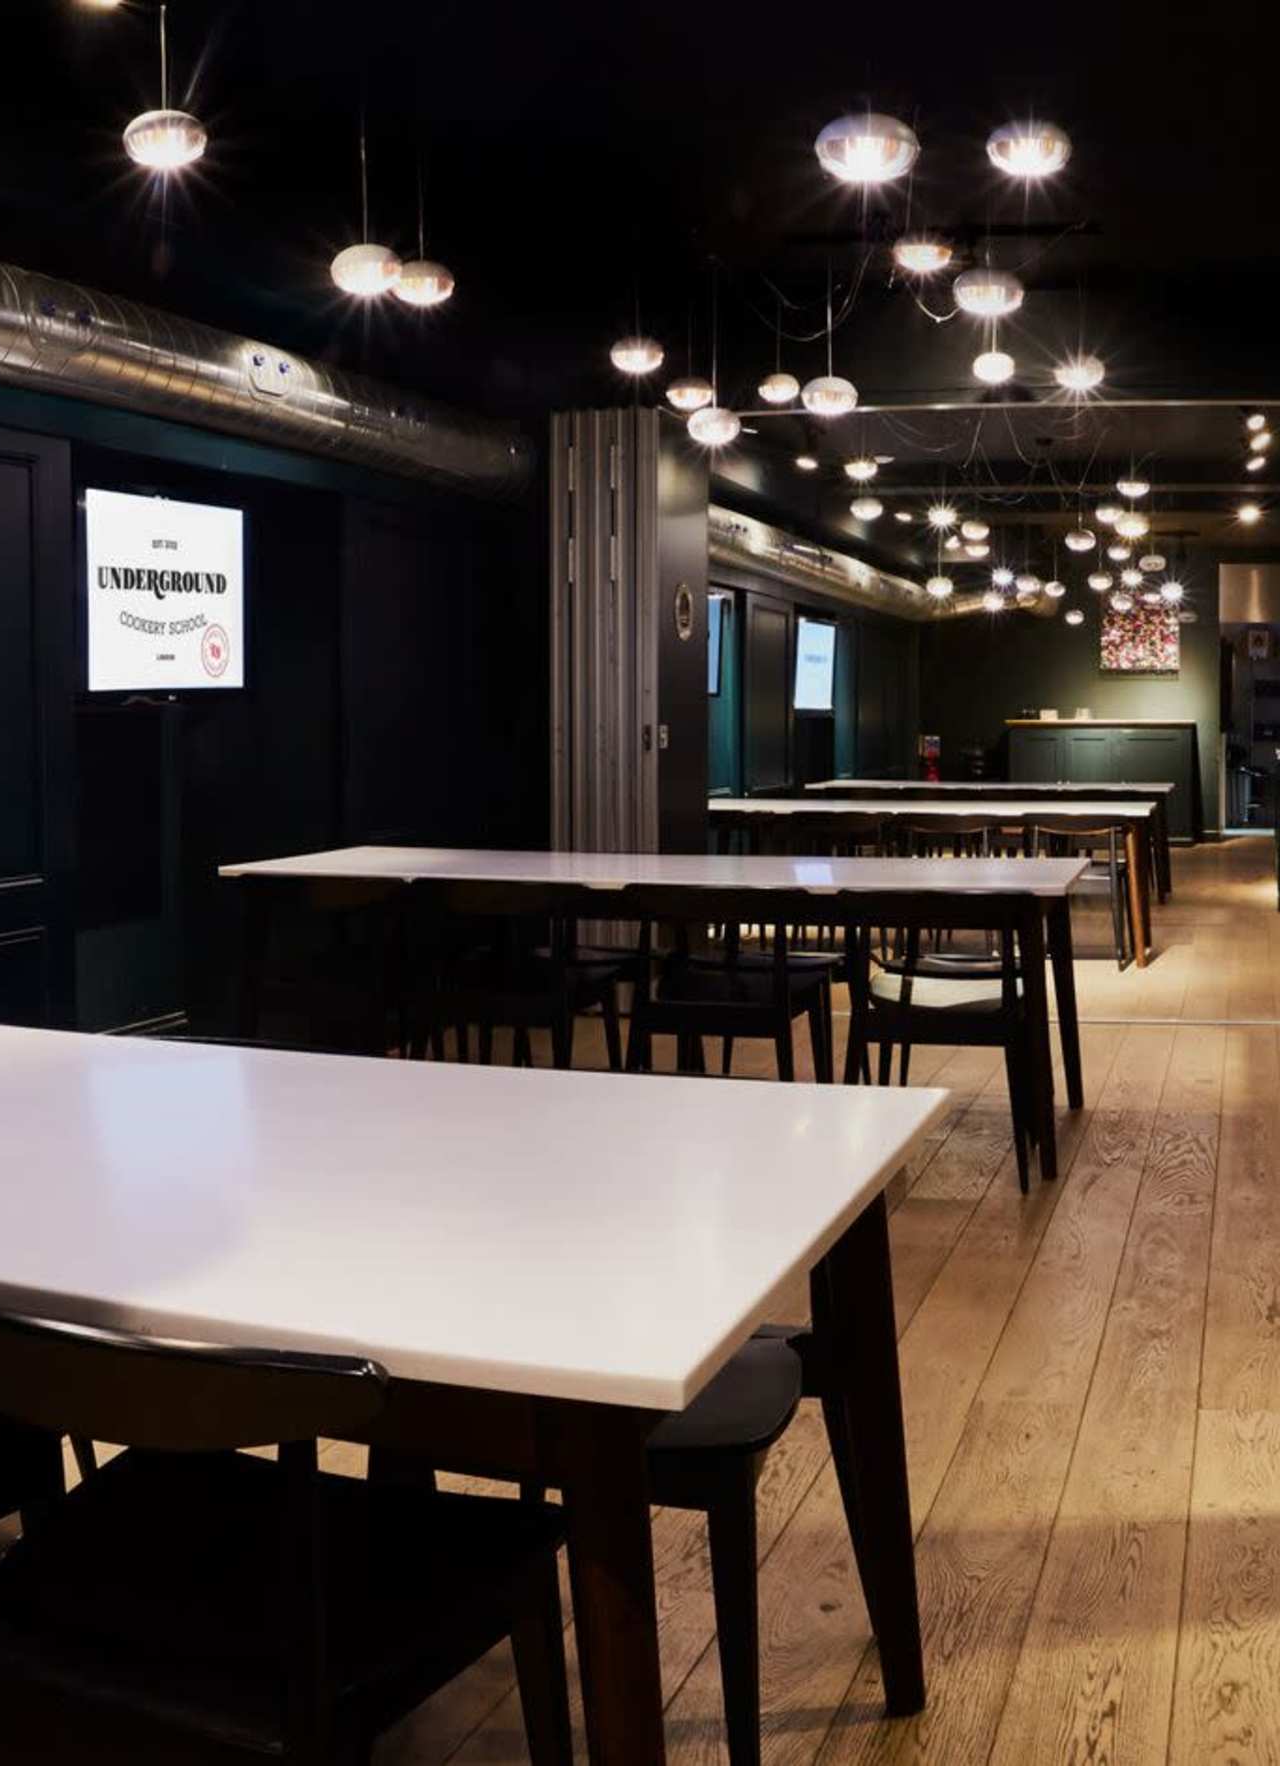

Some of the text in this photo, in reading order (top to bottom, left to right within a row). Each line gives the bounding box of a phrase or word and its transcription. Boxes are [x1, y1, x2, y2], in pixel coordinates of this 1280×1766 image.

[97, 565, 227, 600] UNDERGROUND
[119, 610, 208, 635] COOKERY SCHOOL
